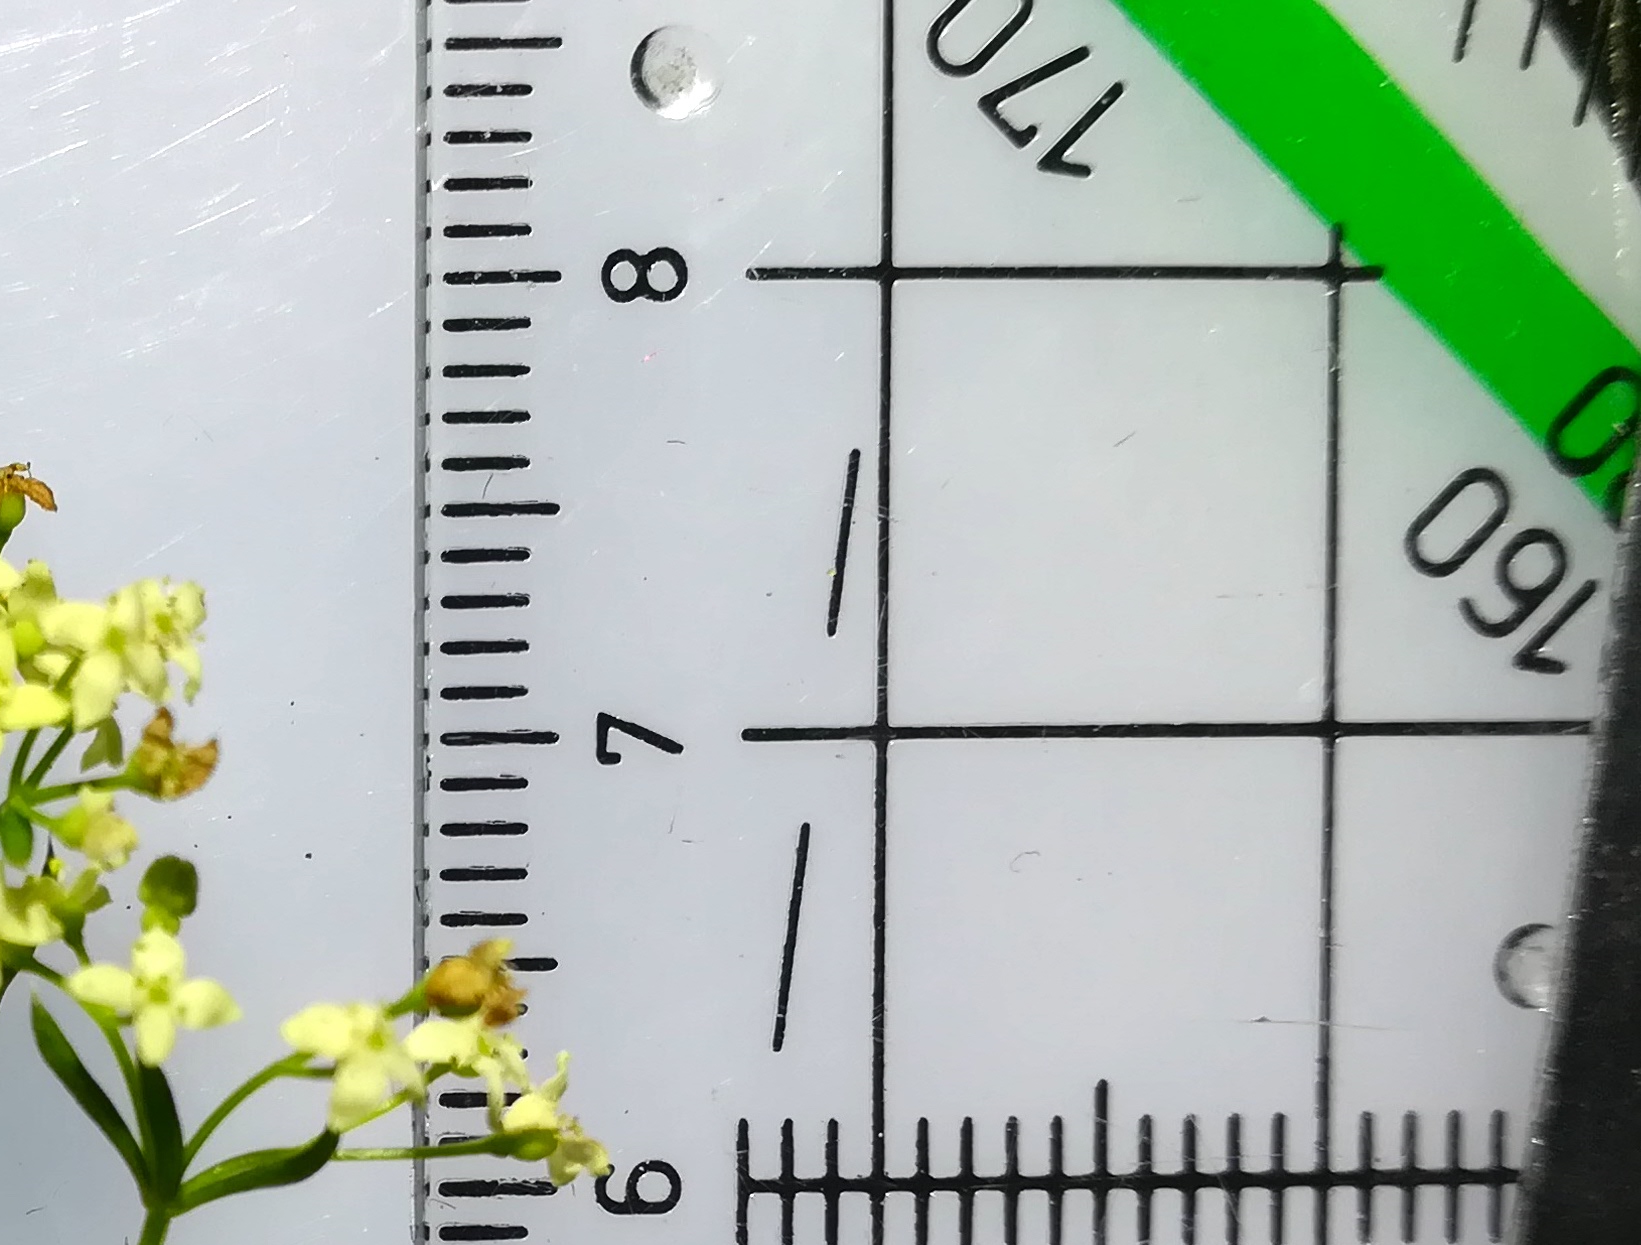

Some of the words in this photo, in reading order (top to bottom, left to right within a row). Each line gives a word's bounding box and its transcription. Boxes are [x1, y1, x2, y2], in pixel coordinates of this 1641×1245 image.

[926, 0, 1126, 178] 170
[601, 247, 688, 303] 8
[1406, 466, 1598, 674] 160
[596, 712, 684, 765] 7
[595, 1158, 682, 1215] 6
